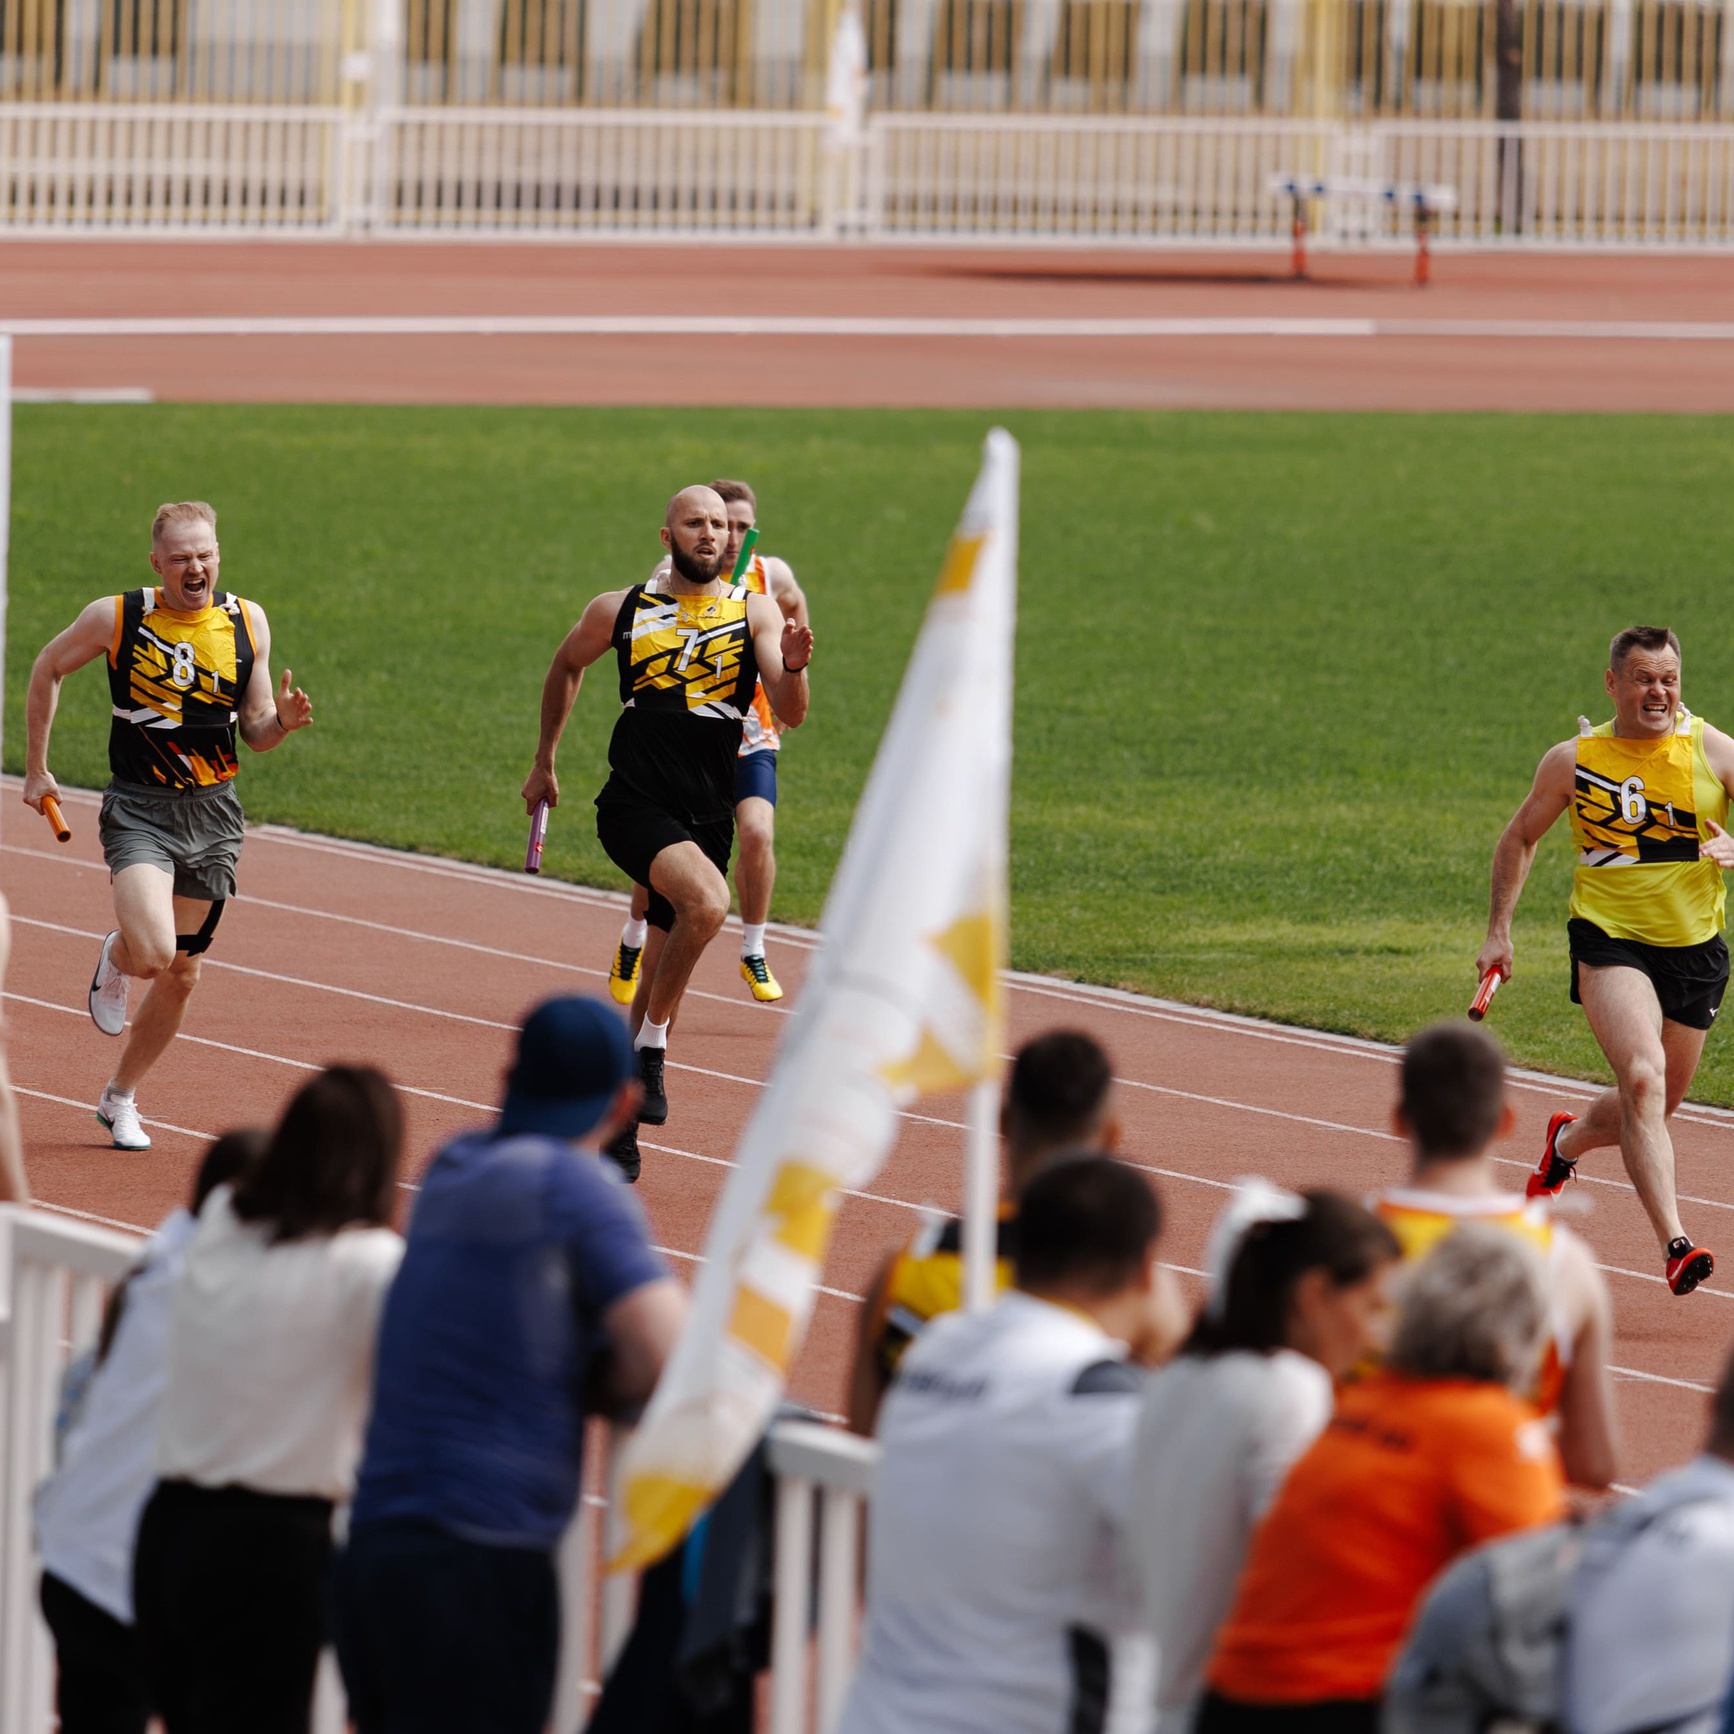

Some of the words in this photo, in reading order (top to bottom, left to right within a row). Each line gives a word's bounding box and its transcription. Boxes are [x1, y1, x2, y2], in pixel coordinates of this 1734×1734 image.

[172, 641, 196, 687] 8
[675, 628, 700, 672] 7
[714, 655, 723, 679] 1
[211, 669, 220, 693] 1
[1620, 775, 1647, 825] 6
[1664, 801, 1675, 827] 1
